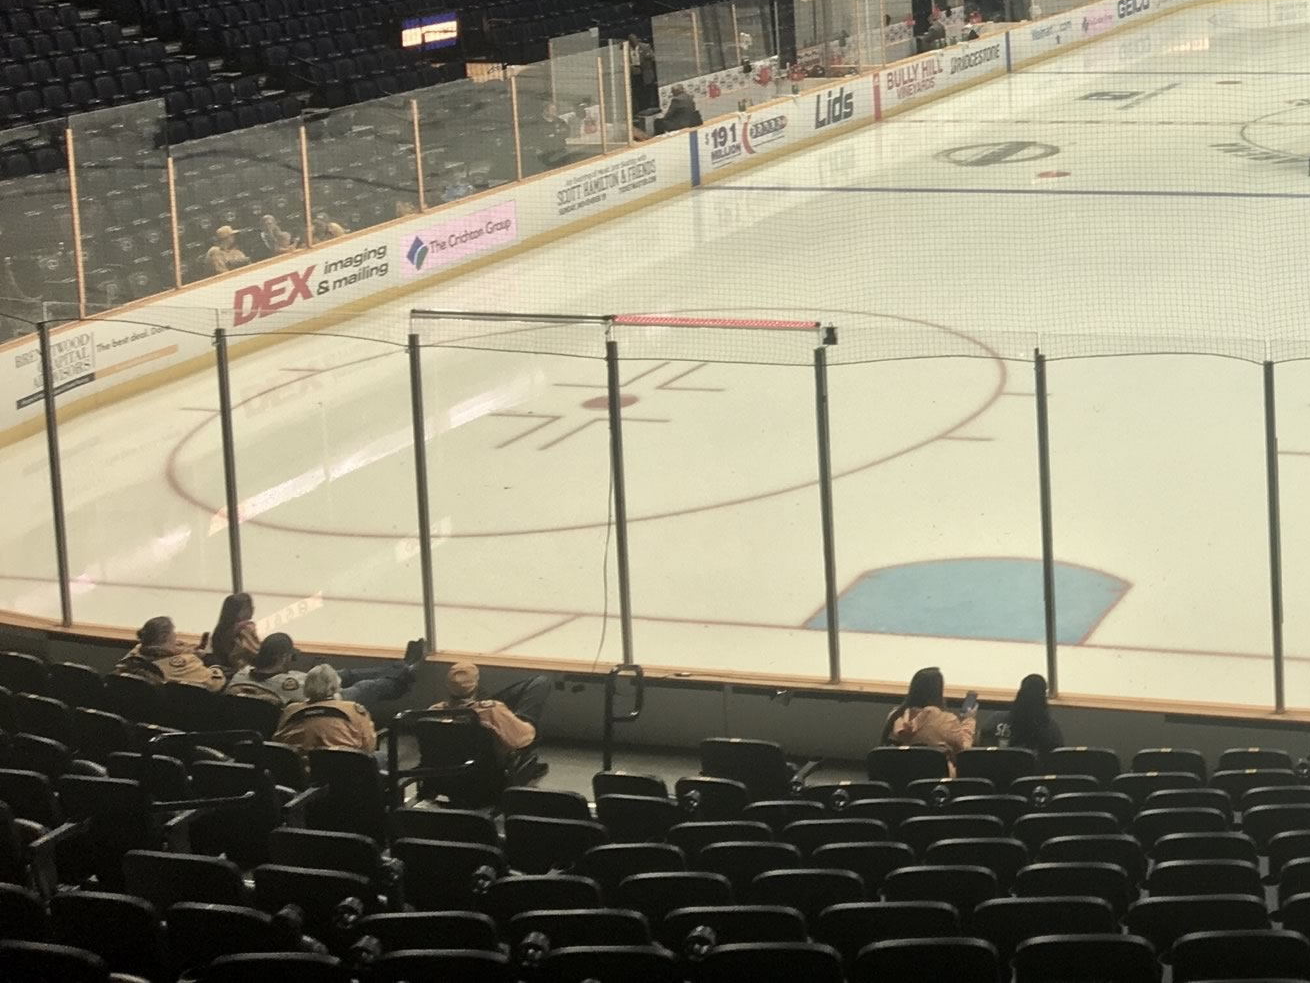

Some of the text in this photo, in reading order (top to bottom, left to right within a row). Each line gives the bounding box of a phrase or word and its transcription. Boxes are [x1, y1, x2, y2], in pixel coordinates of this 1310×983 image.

[887, 54, 944, 92] BULLY HILL
[949, 43, 1001, 75] BRIDGESTONE
[897, 77, 936, 101] VINEYARDS
[815, 87, 854, 129] Lids
[556, 184, 581, 206] SCOTT
[583, 172, 619, 197] HAMILTON
[628, 158, 657, 181] FRIENDS
[429, 218, 512, 253] The Crichton Group
[324, 245, 387, 275] imaging
[233, 264, 317, 328] DEX
[317, 261, 389, 296] & mailing
[112, 336, 129, 348] best
